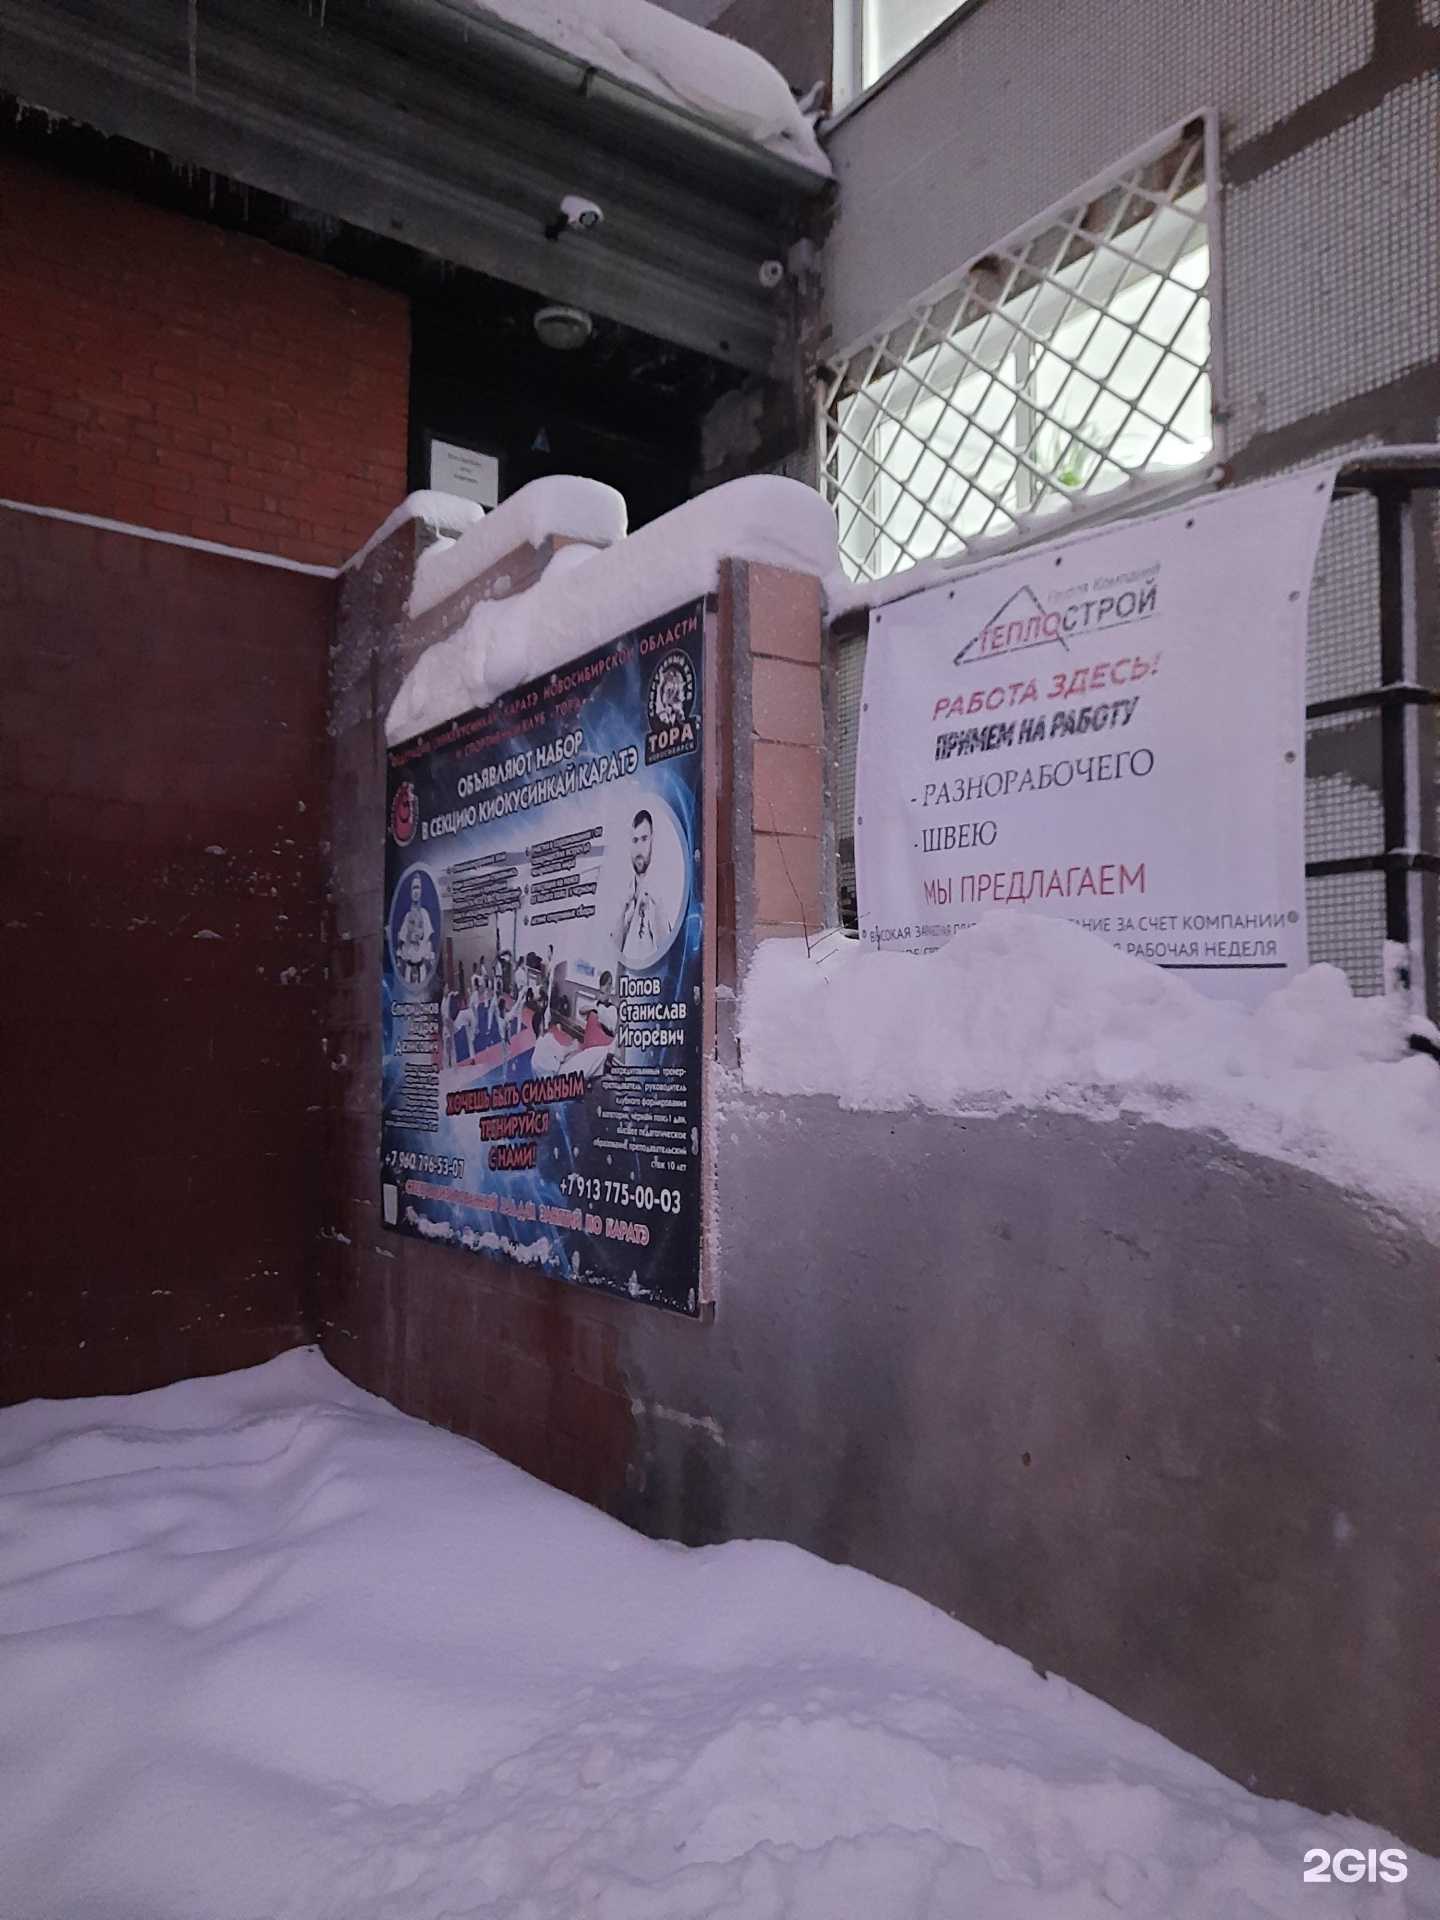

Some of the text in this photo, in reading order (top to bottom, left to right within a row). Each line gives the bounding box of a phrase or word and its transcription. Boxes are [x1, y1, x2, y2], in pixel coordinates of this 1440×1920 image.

[980, 579, 1158, 652] ТЕПЛОСТРОЙ
[640, 615, 698, 656] ОБЛАСТИ
[932, 652, 1162, 721] РАБОТА ЗДЕСЬ!
[648, 722, 694, 754] ТОРА
[935, 696, 1140, 761] ПРИМЕМ НА РАБОТУ
[457, 729, 584, 798] ОБЪЯВЛЯЮТ НАБОР
[421, 746, 639, 840] В СЕКЦИЮ КИОКУСИНКАЙ КАРАТЭ
[921, 863, 1146, 905] МЫ ПРЕДЛАГАЕМ
[1116, 917, 1135, 932] ЗА
[1138, 915, 1178, 931] СЧЕТ
[1182, 913, 1285, 931] КОМПАНИИ
[1127, 942, 1199, 958] РАБОЧАЯ
[1205, 941, 1278, 958] НЕДЕЛЯ
[619, 976, 661, 997] Попов
[618, 1000, 687, 1022] Станислав
[618, 1026, 685, 1051] Игоревич
[447, 1072, 584, 1114] ХОЧЕШЬ БЫТЬ СИЛЬНЫМ
[480, 1111, 549, 1142] ТРЕНИРУЙСЯ
[489, 1144, 537, 1170] С НАМИ!
[667, 1161, 676, 1171] 10
[559, 1173, 681, 1214] +7 913 775-00-03
[585, 1212, 603, 1235] ПО
[605, 1217, 650, 1247] КАРАТЭ
